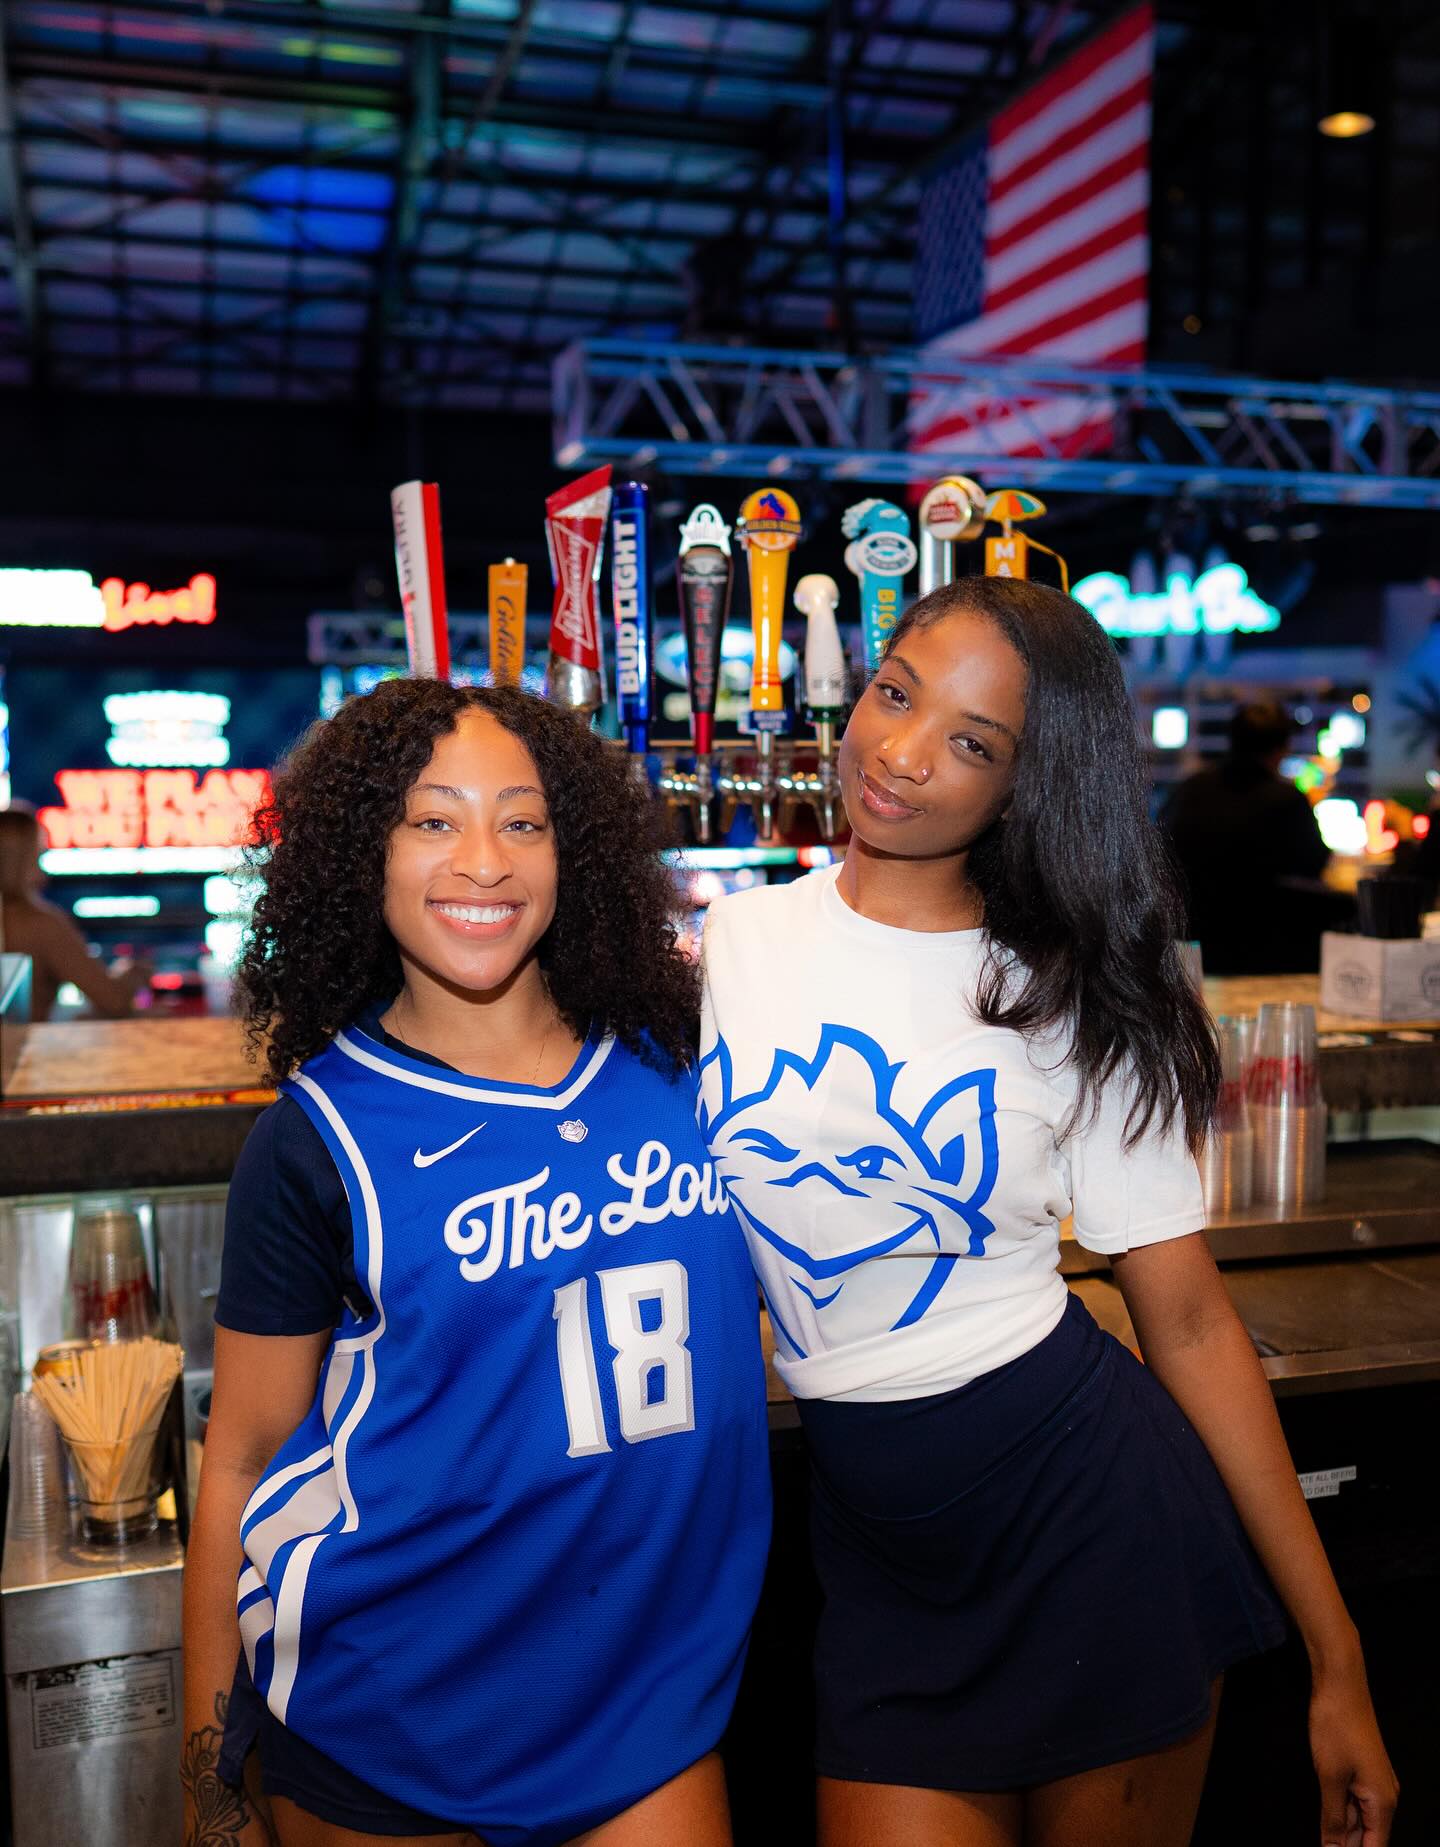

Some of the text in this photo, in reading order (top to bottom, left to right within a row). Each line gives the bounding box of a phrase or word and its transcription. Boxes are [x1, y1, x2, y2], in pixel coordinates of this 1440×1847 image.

[613, 519, 640, 695] BUD LIGHT
[877, 588, 897, 629] BIG
[443, 1165, 593, 1282] The
[552, 1258, 697, 1459] 18
